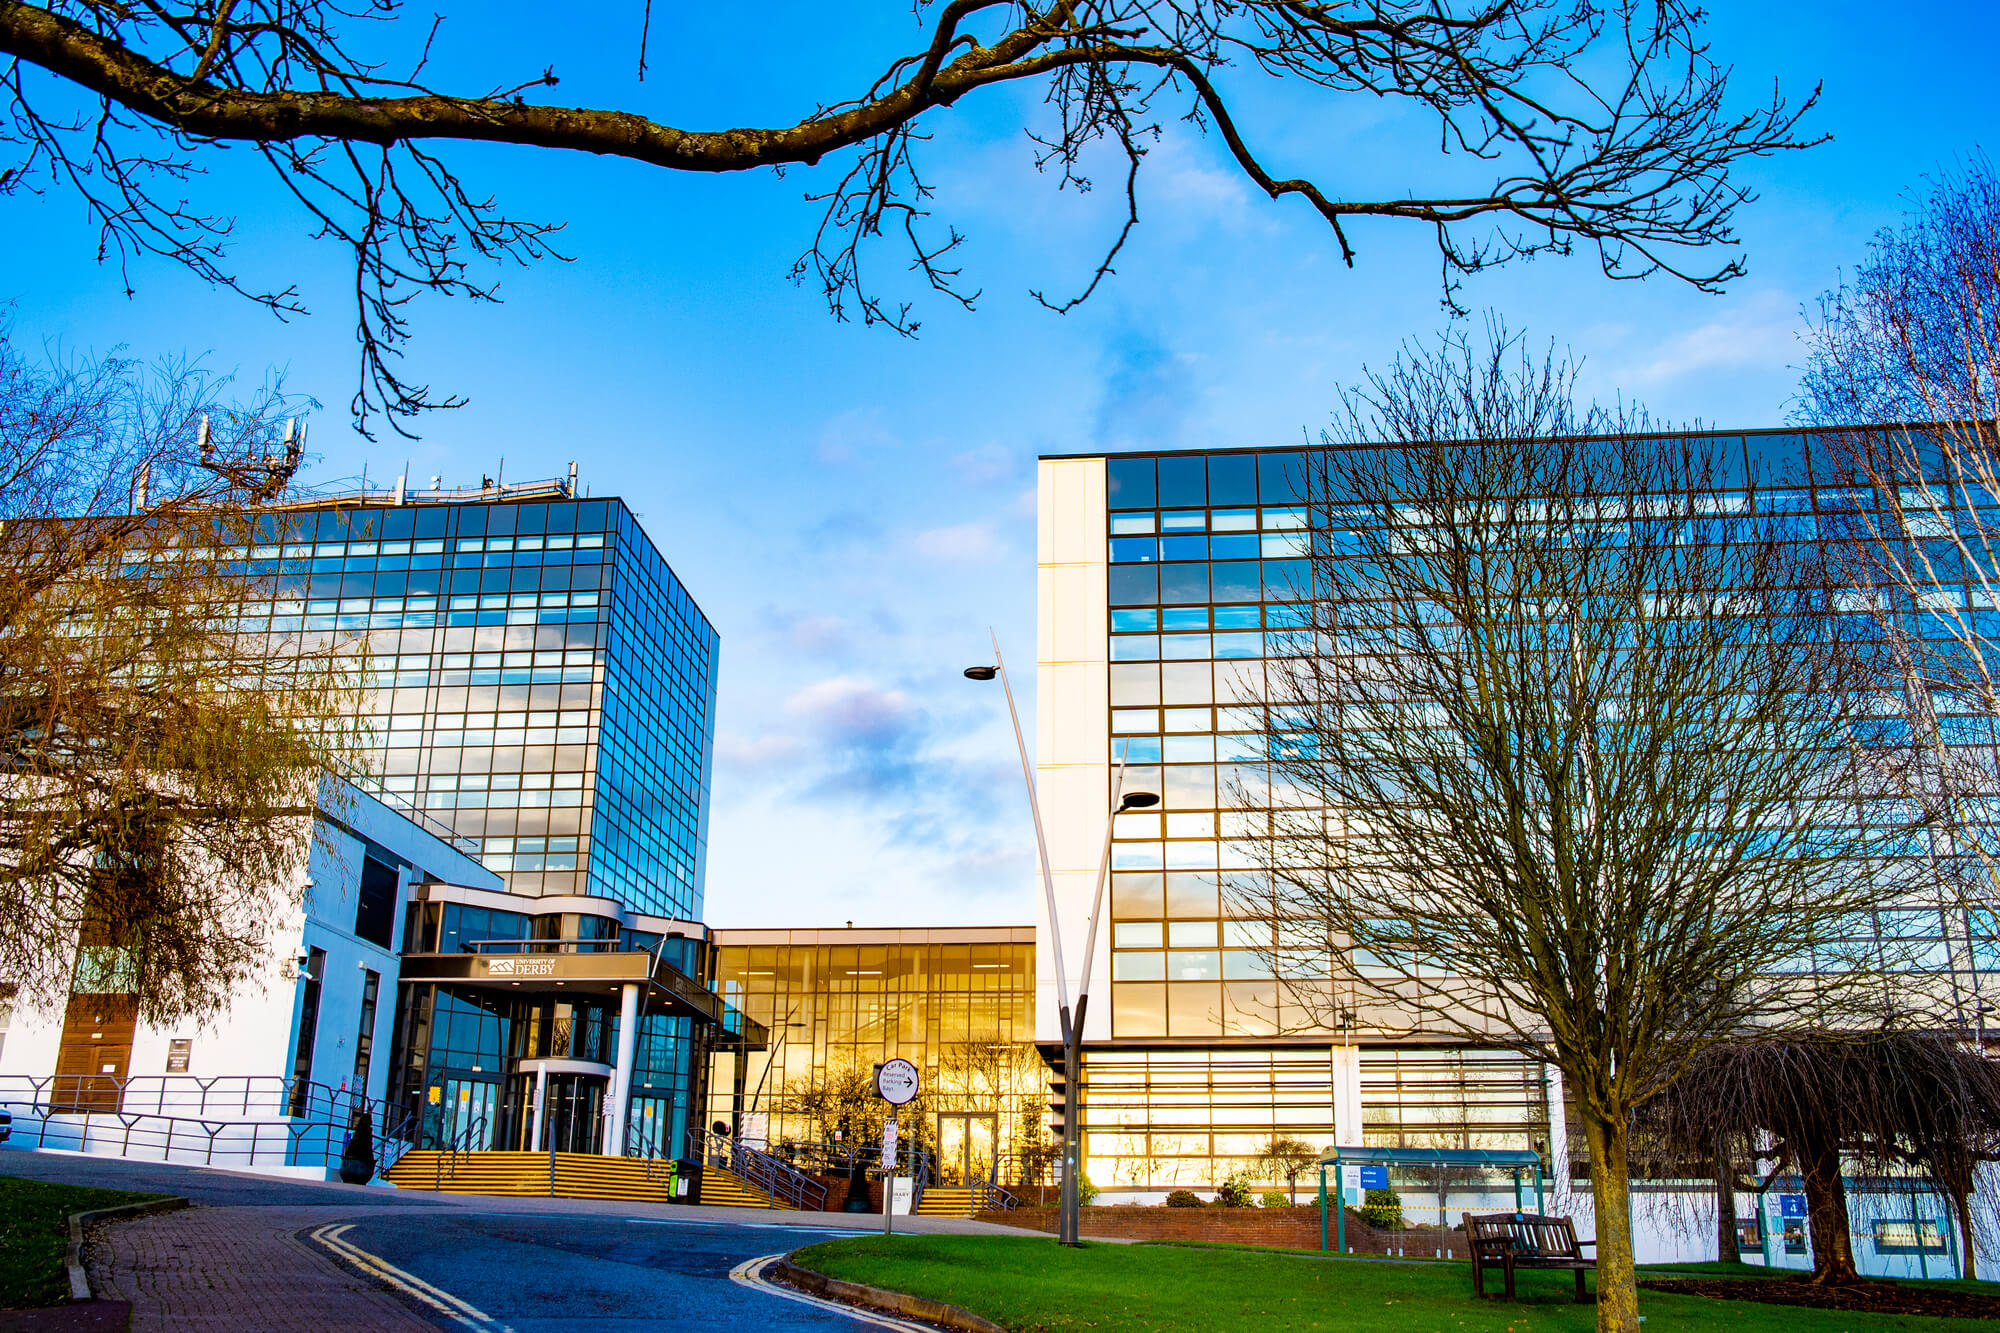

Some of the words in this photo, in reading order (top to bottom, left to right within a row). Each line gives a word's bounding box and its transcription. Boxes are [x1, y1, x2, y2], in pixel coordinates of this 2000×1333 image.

[515, 964, 555, 975] DERBY
[887, 1063, 897, 1071] Car
[898, 1062, 911, 1072] Park
